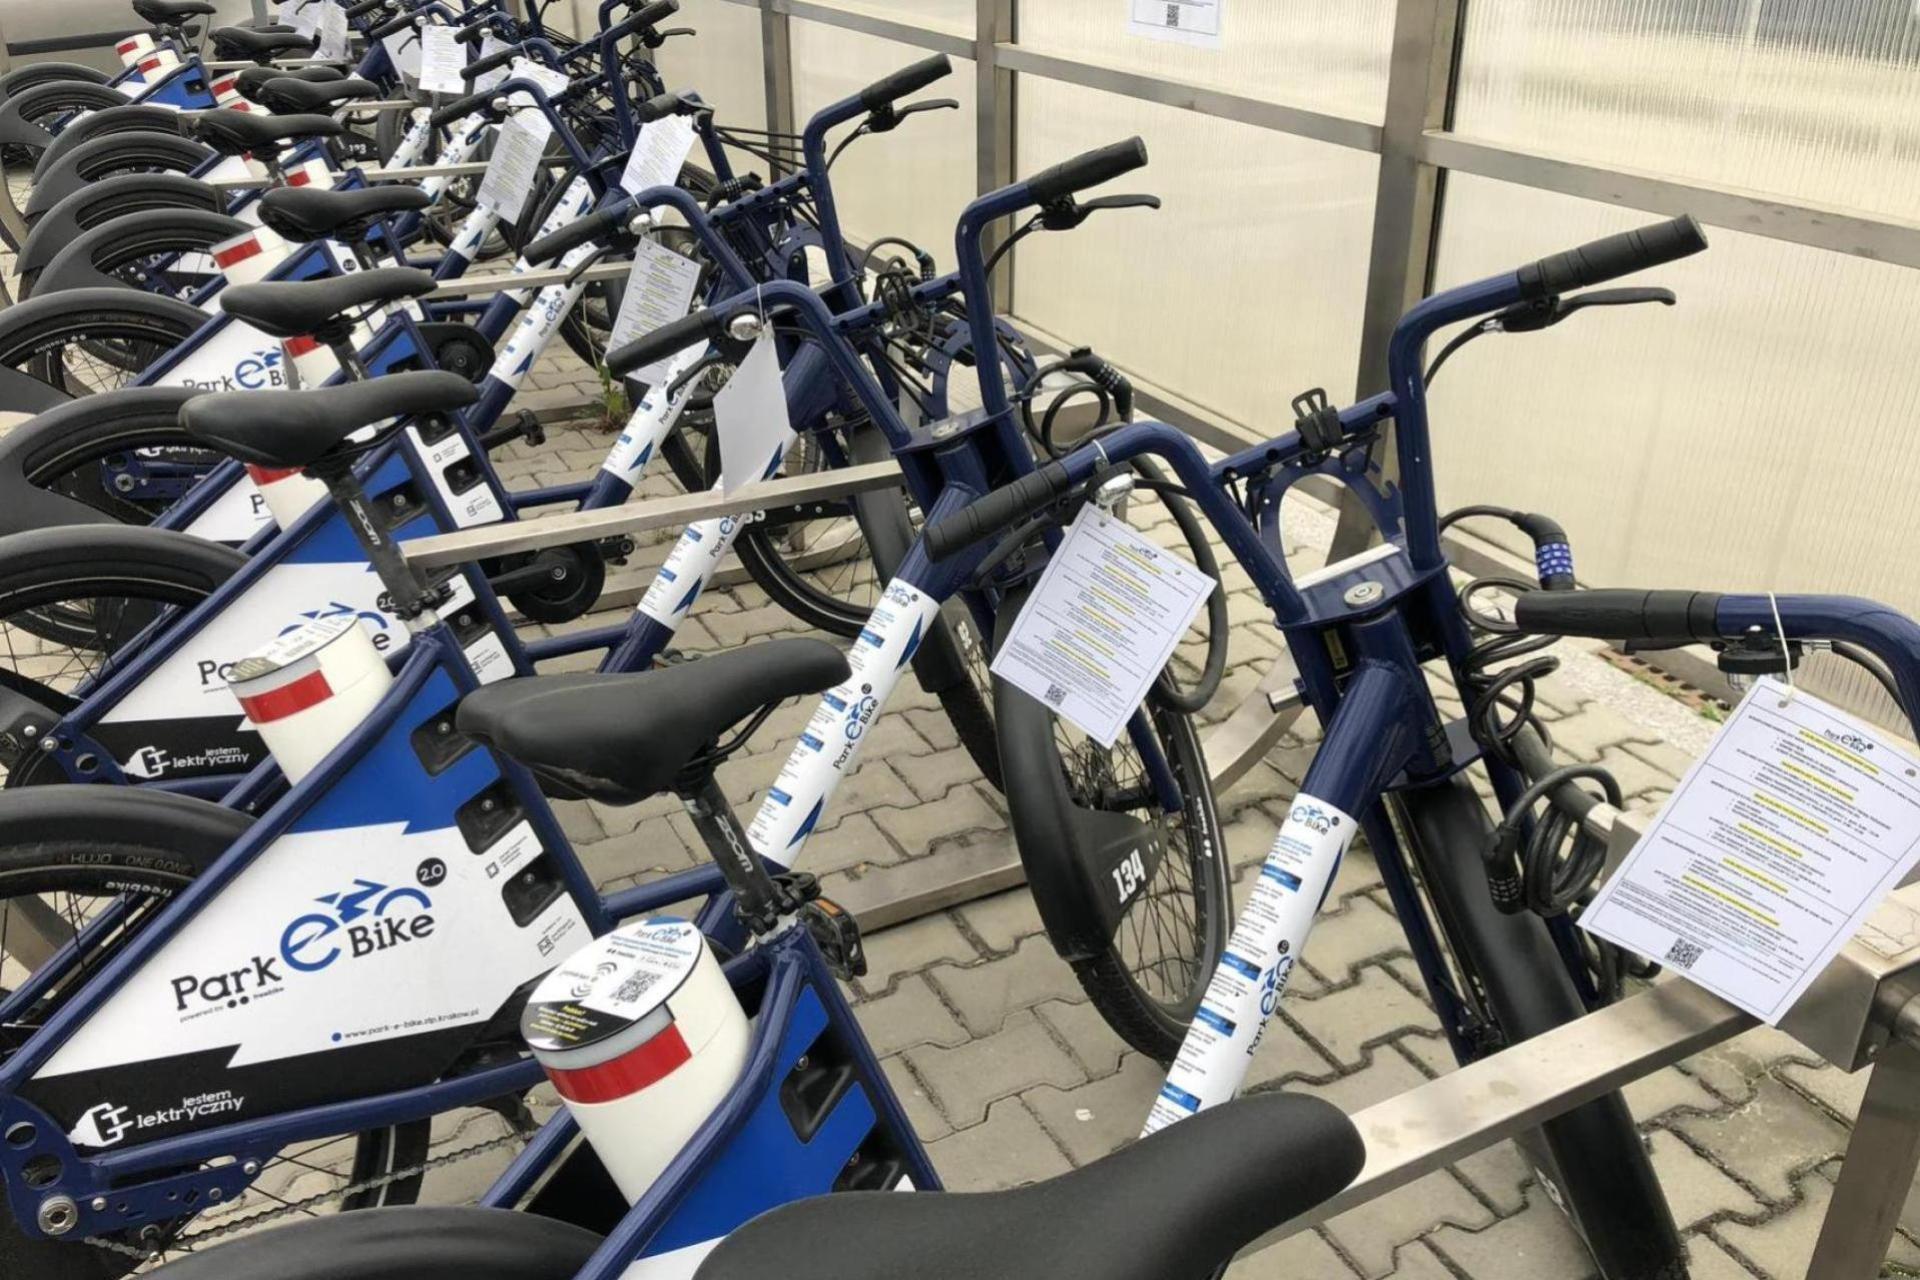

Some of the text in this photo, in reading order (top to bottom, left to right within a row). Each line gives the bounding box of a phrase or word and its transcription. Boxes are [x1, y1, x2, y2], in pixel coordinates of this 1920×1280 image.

[833, 743, 856, 770] Park
[859, 698, 880, 725] Bike
[206, 746, 241, 757] jestem
[1304, 816, 1329, 836] Bike
[418, 862, 446, 884] 2.0
[1112, 848, 1147, 905] 134
[105, 880, 173, 899] freebike
[171, 913, 436, 1012] Park e Bike
[1246, 1018, 1270, 1057] Park
[1276, 958, 1295, 994] Bike
[183, 1089, 233, 1110] jestem
